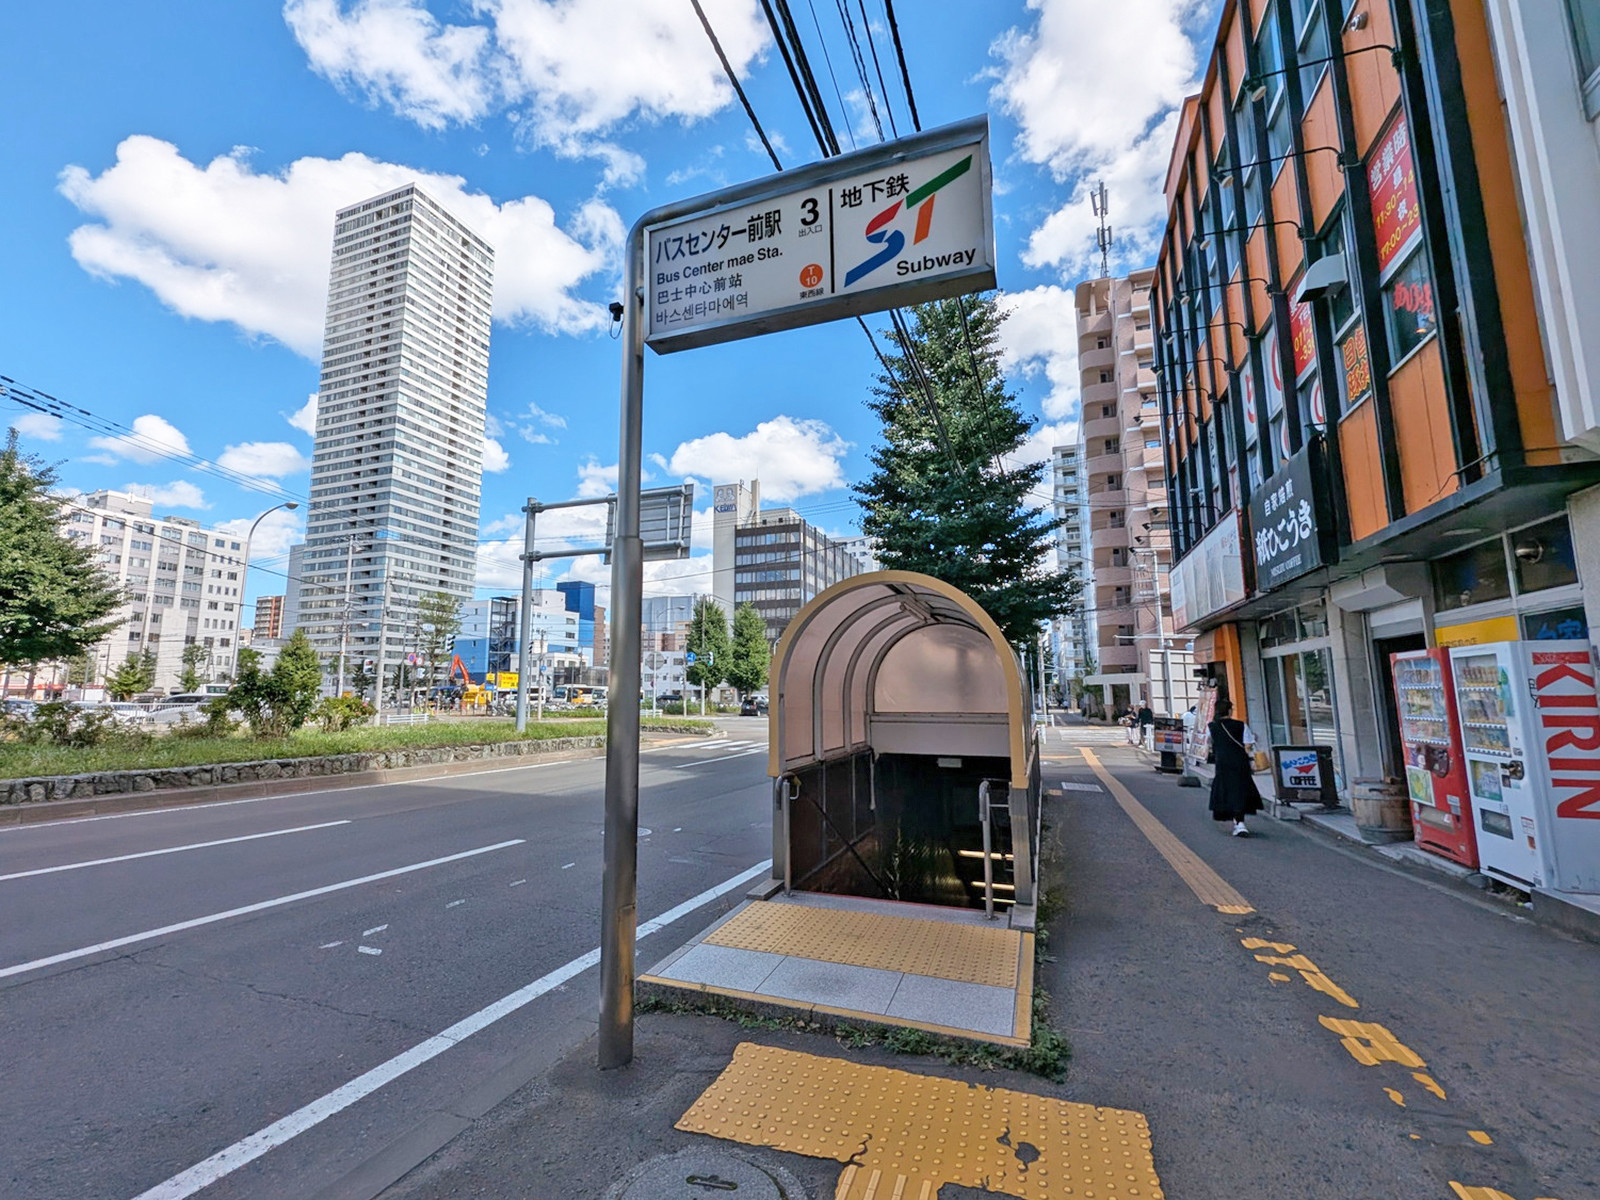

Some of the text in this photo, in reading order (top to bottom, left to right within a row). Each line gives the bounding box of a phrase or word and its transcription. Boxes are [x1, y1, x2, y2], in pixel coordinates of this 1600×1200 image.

[840, 174, 910, 209] 地下鉄
[800, 198, 820, 226] 3
[656, 209, 782, 264] バスセンター前駅
[798, 225, 823, 238] 出入口
[657, 246, 784, 286] Bus Center mae Sta.
[807, 266, 815, 275] T
[896, 248, 977, 277] Subway
[657, 272, 743, 305] 巴士中心前站
[800, 287, 824, 300] 東西線
[806, 275, 818, 285] 10
[656, 291, 749, 325] 바스센타마에역
[1255, 499, 1312, 566] 紙ひこうき
[1532, 651, 1600, 820] KIRIN
[1290, 775, 1317, 786] COFFEE
